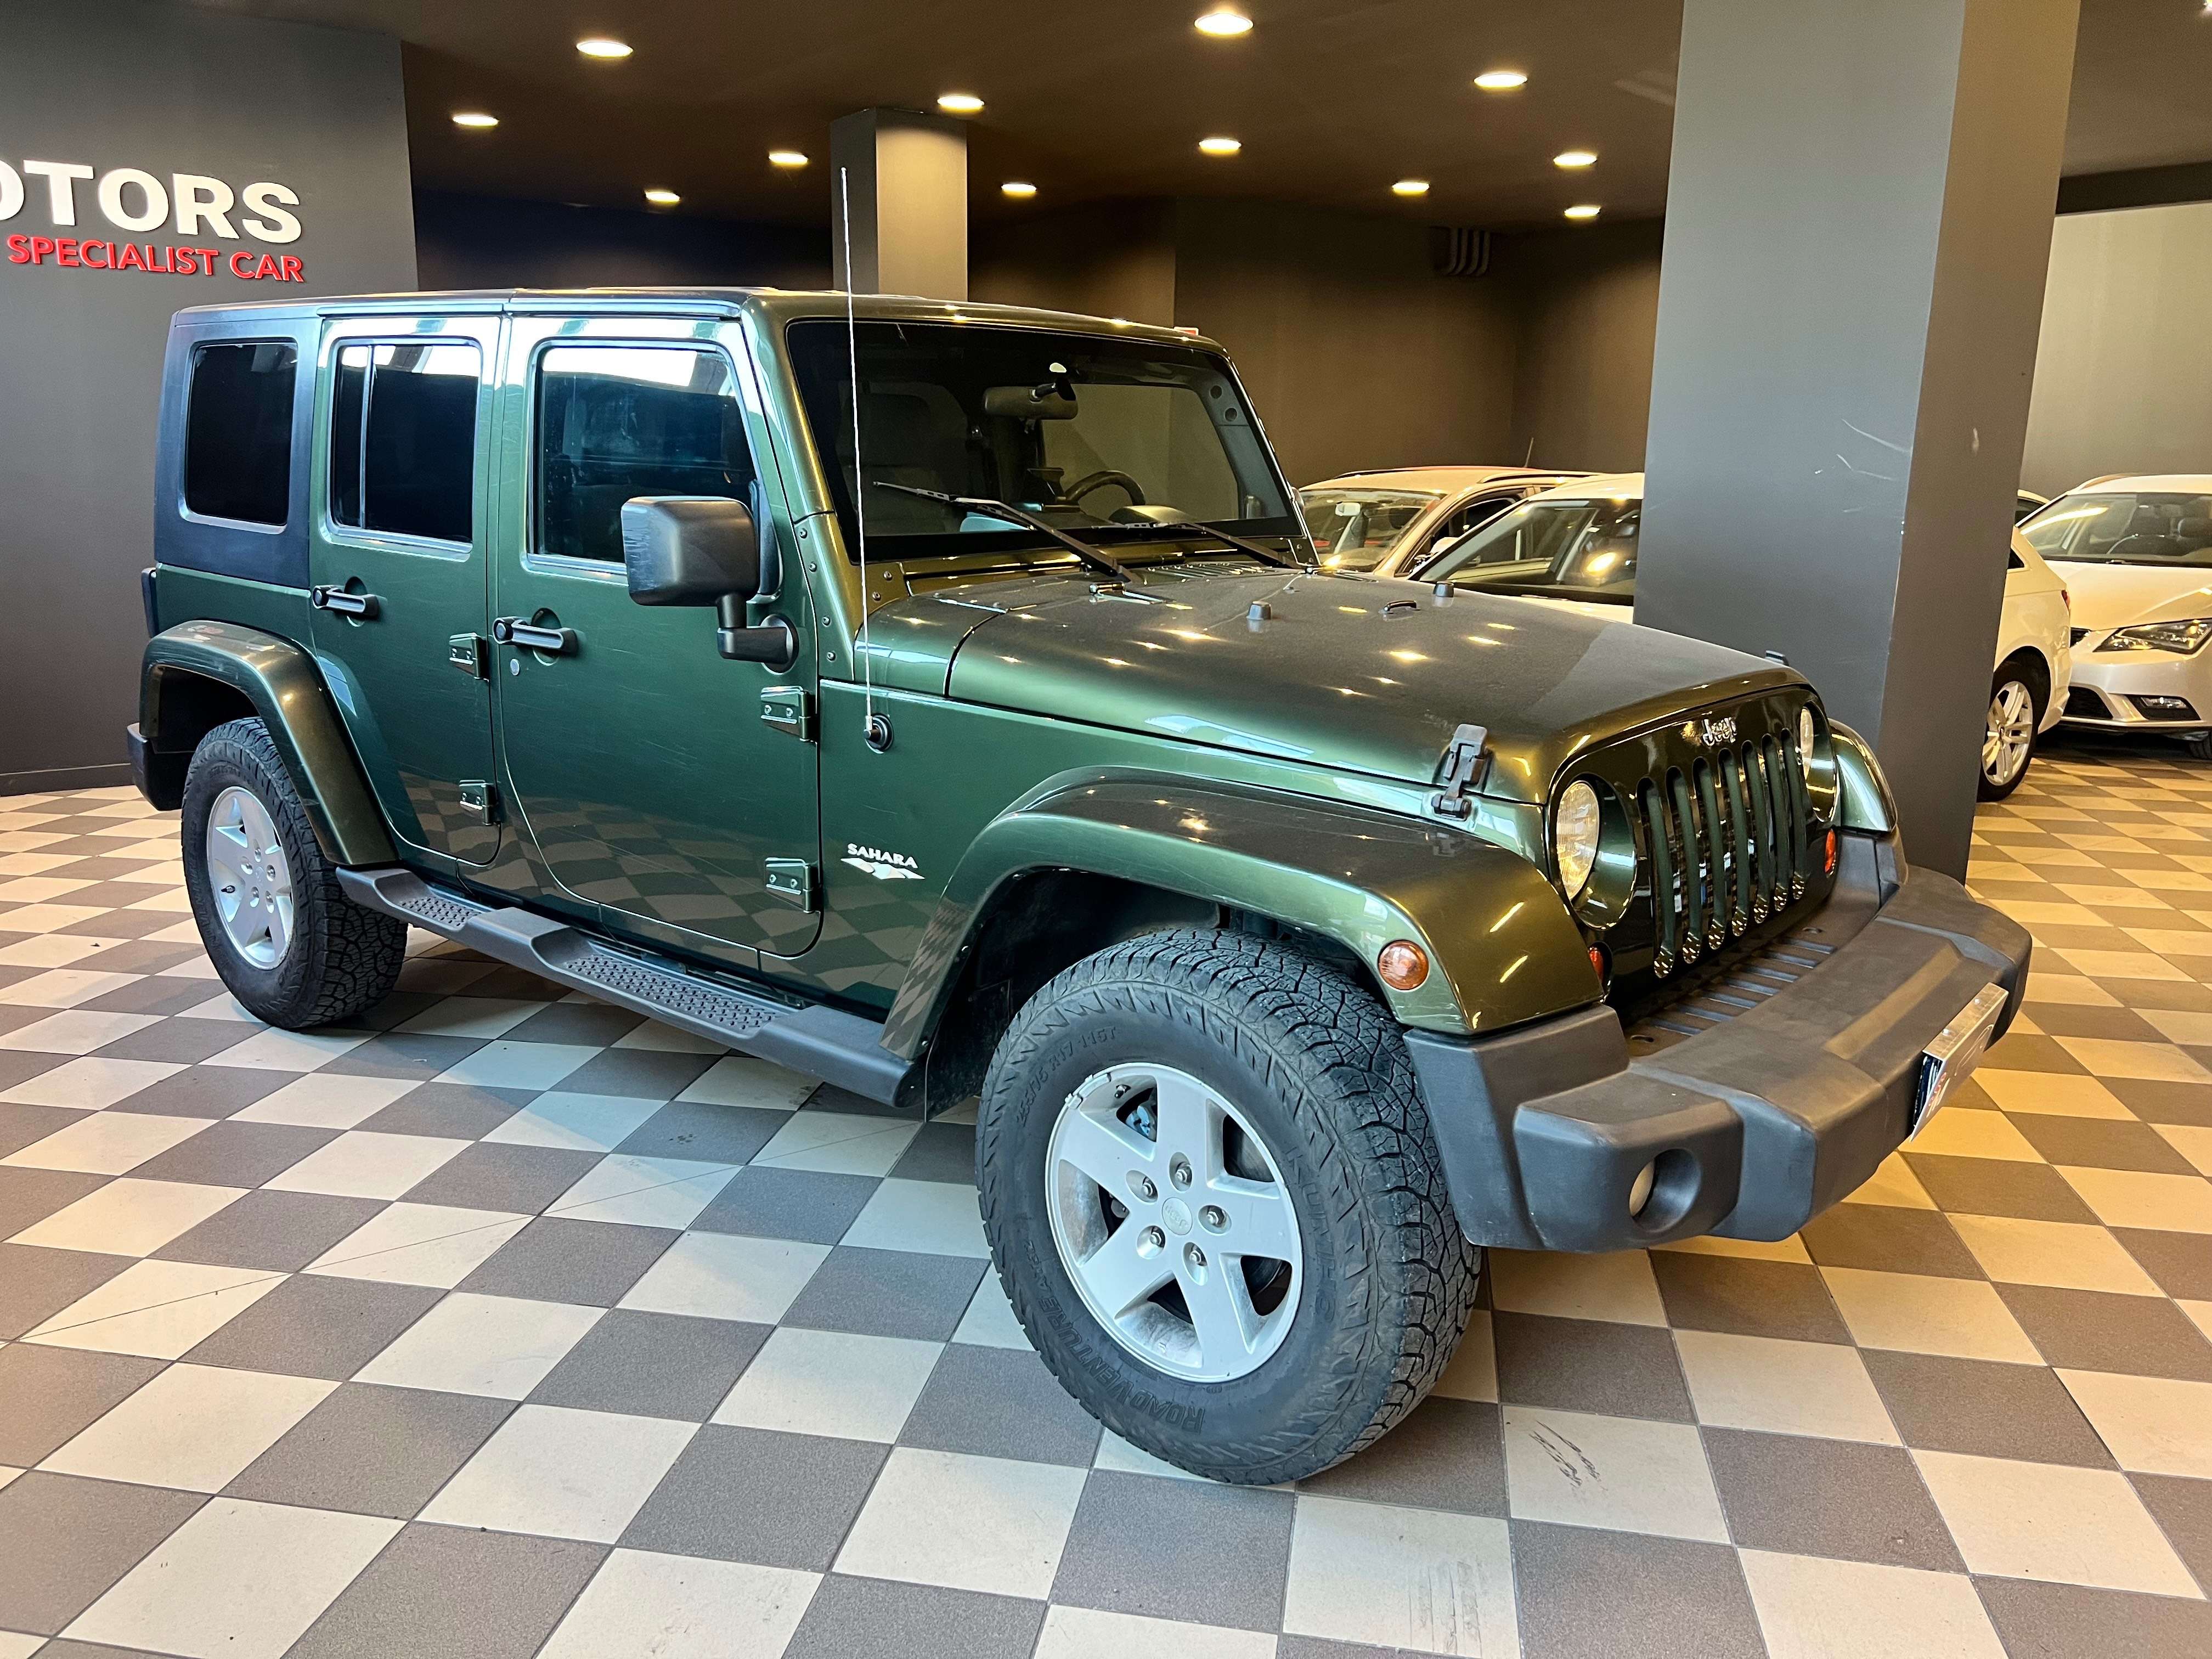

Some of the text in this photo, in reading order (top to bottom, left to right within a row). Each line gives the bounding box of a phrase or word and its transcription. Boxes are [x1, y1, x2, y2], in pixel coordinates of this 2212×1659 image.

[7, 234, 305, 283] SPECIALIST CAR
[1702, 716, 1737, 747] Jeep
[847, 843, 918, 869] SAHARA
[1284, 1146, 1337, 1323] KUMHO
